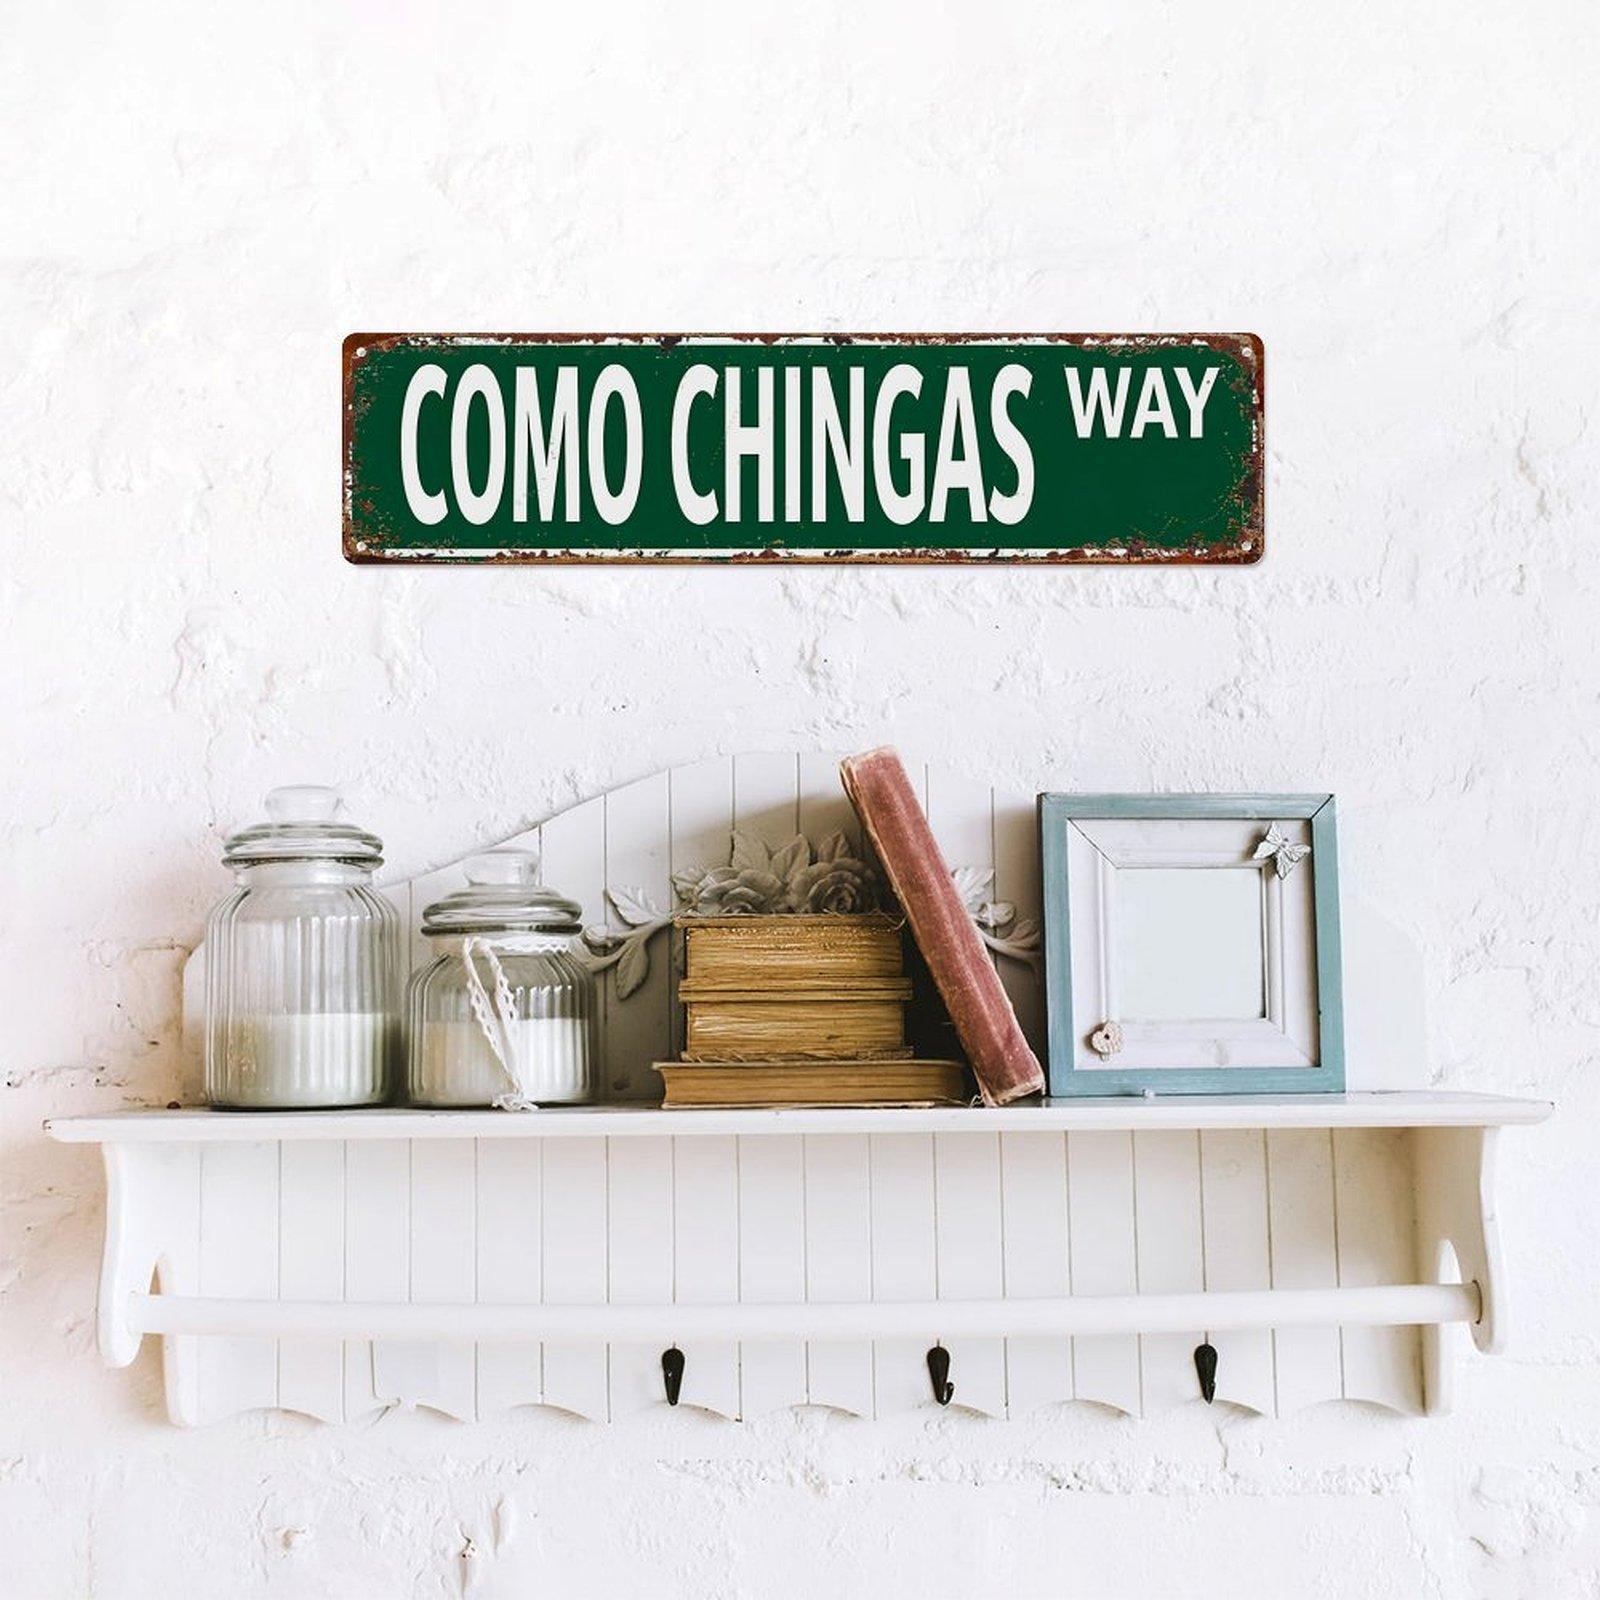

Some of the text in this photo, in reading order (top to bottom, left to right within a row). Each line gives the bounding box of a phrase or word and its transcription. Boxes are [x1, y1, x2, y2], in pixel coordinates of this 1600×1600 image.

[400, 364, 1220, 525] COMO CHINGAS WAY
